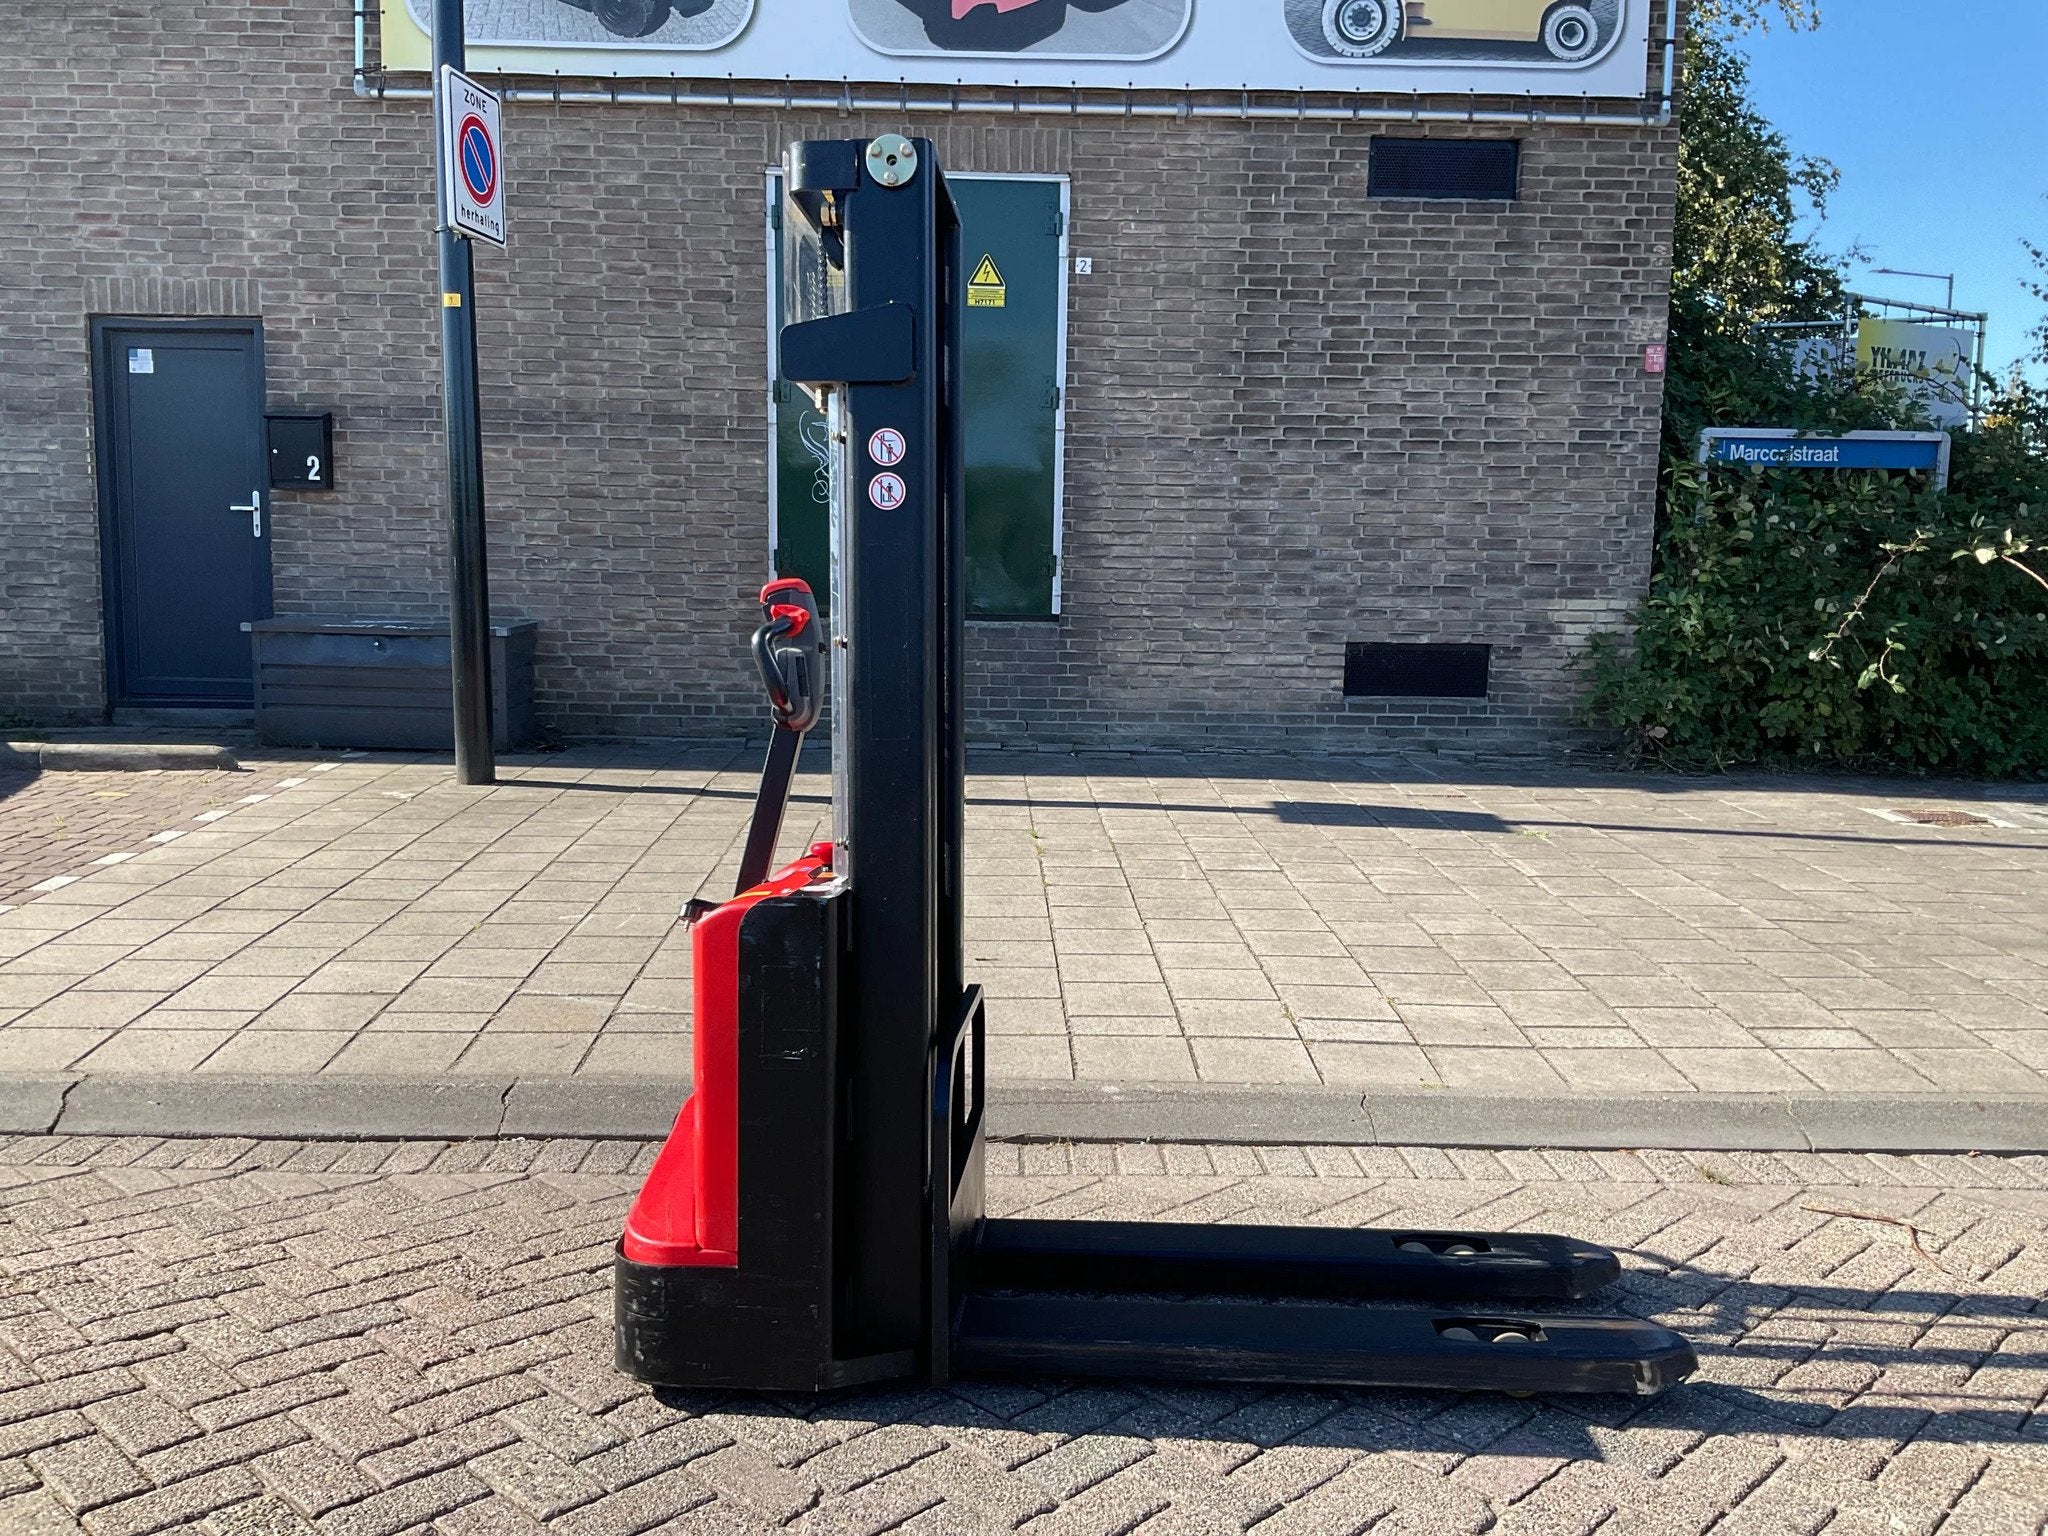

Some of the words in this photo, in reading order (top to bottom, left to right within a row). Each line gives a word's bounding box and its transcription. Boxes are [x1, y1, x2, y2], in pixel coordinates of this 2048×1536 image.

[464, 88, 487, 114] ZONE
[461, 203, 500, 236] herhaling
[1079, 259, 1087, 273] 2
[306, 455, 321, 481] 2
